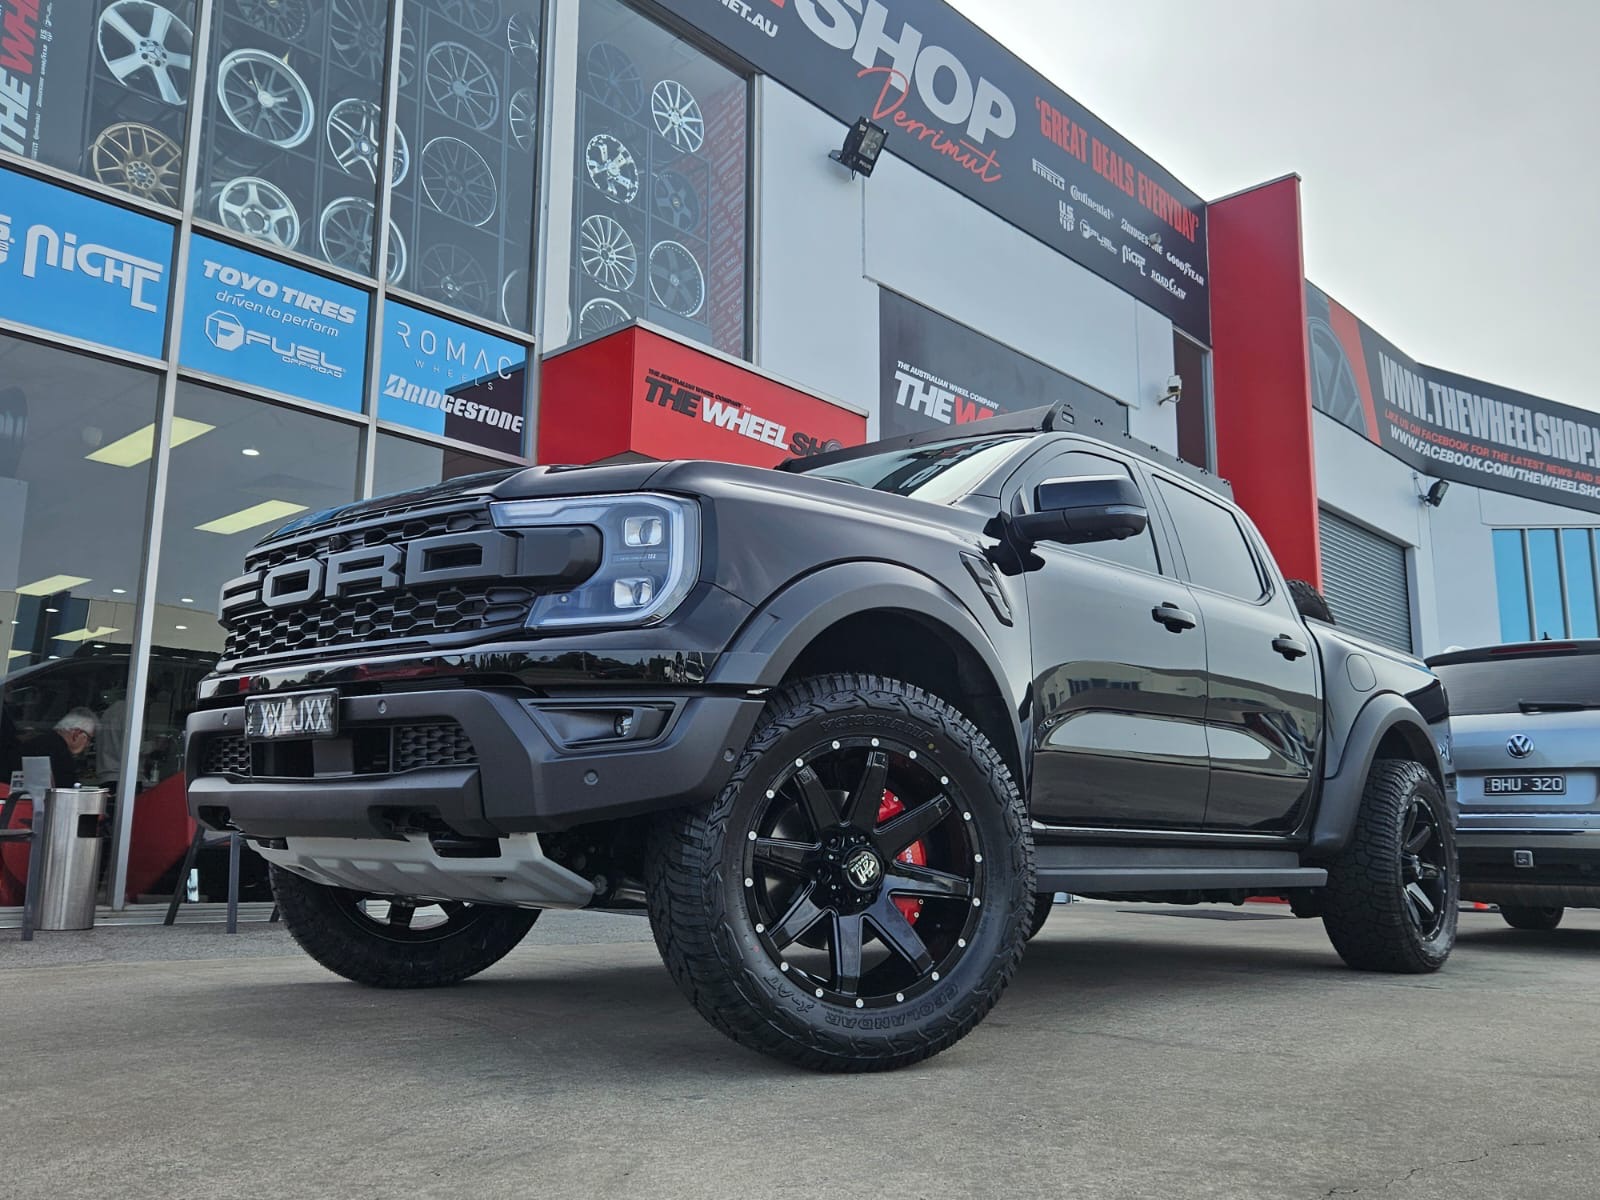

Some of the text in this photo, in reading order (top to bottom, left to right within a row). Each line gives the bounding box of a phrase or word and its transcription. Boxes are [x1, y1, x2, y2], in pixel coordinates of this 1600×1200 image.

[717, 0, 778, 37] ET.AU
[794, 0, 1017, 144] SHOP
[857, 66, 1002, 182] Derrimut
[1092, 137, 1135, 197] DEALS
[201, 259, 357, 325] TOYO TIRES
[215, 290, 339, 338] driven to perform
[245, 330, 344, 373] FUEL
[383, 373, 524, 433] BRIDGESTONE
[645, 375, 702, 418] THE
[702, 396, 789, 451] WHEEL
[895, 370, 956, 425] THE
[897, 360, 999, 410] THE AUSTRALIAN WHEEL COMPANY
[1410, 423, 1421, 436] ON
[1421, 429, 1469, 451] FACEBOOK
[1471, 444, 1489, 457] FOR
[1491, 449, 1509, 462] THE
[1510, 455, 1544, 471] LATEST
[1546, 463, 1573, 478] NEWS
[1574, 470, 1594, 482] AND
[217, 530, 506, 625] FORD
